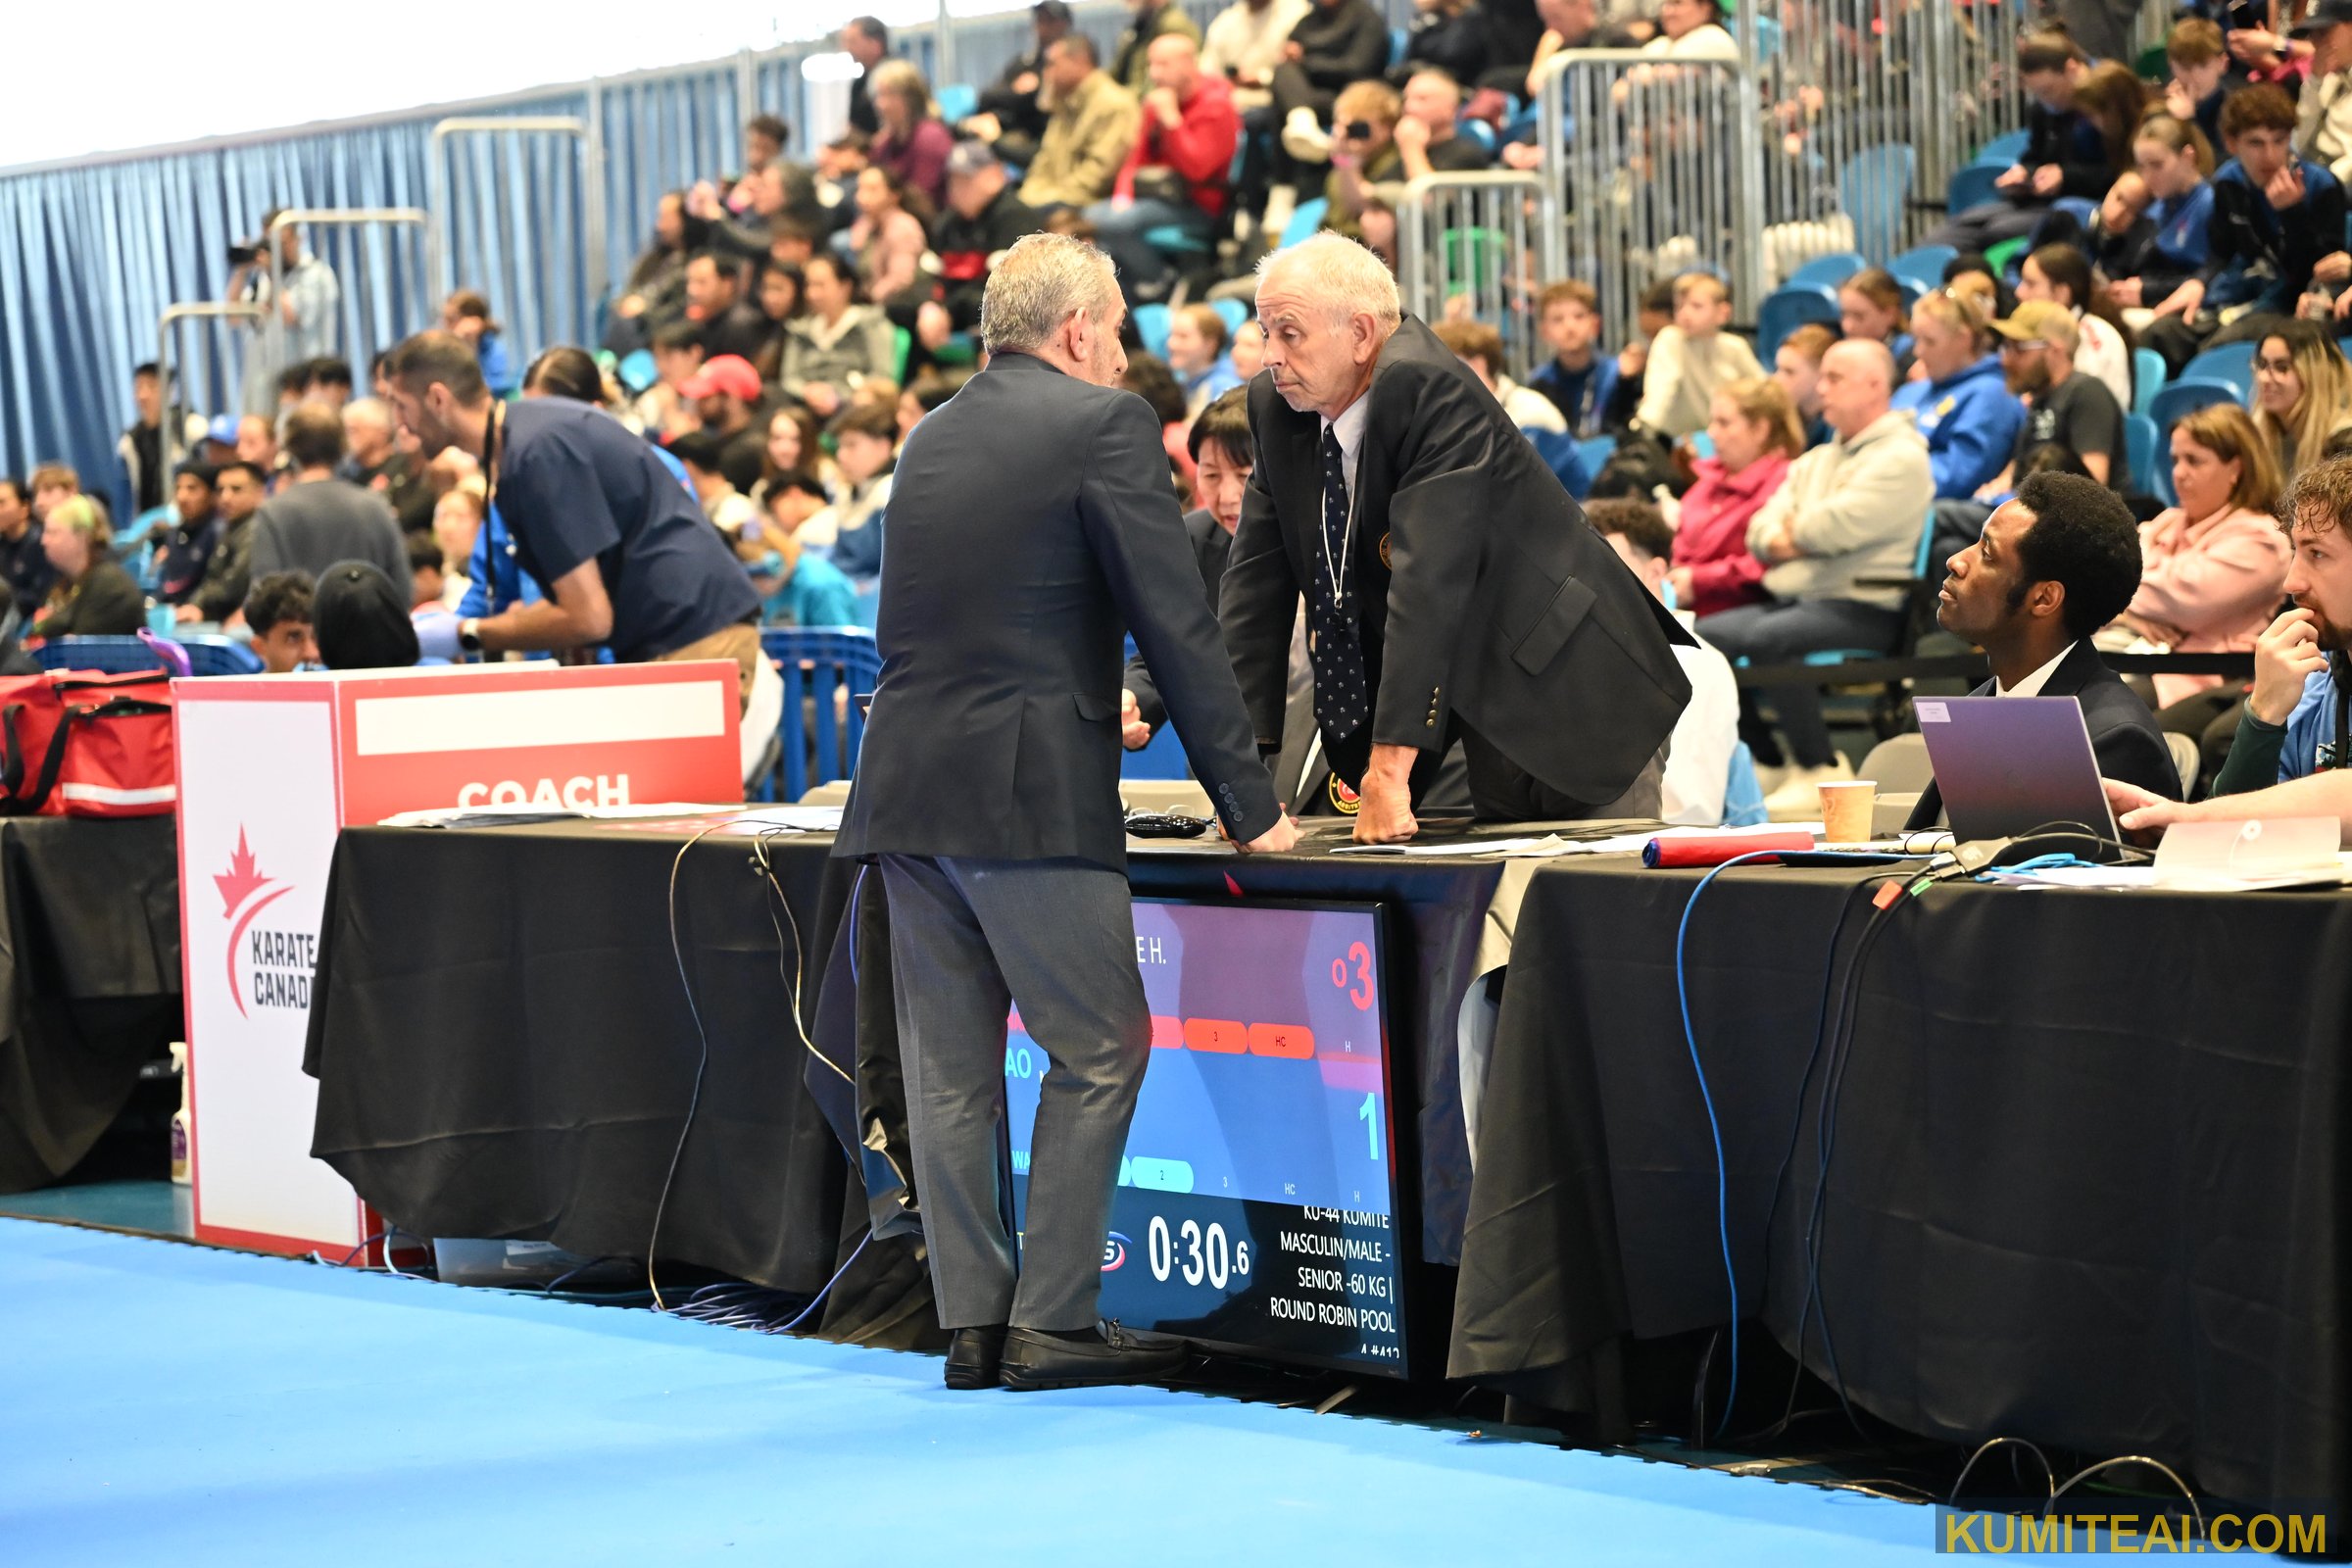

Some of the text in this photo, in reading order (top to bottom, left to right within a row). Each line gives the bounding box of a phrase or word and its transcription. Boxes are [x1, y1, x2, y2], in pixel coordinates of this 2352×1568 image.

[458, 774, 629, 808] COACH
[252, 930, 316, 968] KARATE
[1150, 936, 1166, 964] H.
[1348, 941, 1375, 1011] 3
[1275, 1036, 1286, 1048] HC
[1345, 1040, 1351, 1053] H
[1005, 1048, 1032, 1079] AO
[1359, 1092, 1379, 1160] 1
[1159, 1169, 1360, 1202] 2 3 HC H
[1280, 1231, 1383, 1262] MASCULIN/MALE
[1298, 1266, 1344, 1292] SENIOR
[1346, 1273, 1366, 1295] -60
[1368, 1275, 1387, 1298] KG
[1270, 1297, 1396, 1334] ROUND ROBIN POOL
